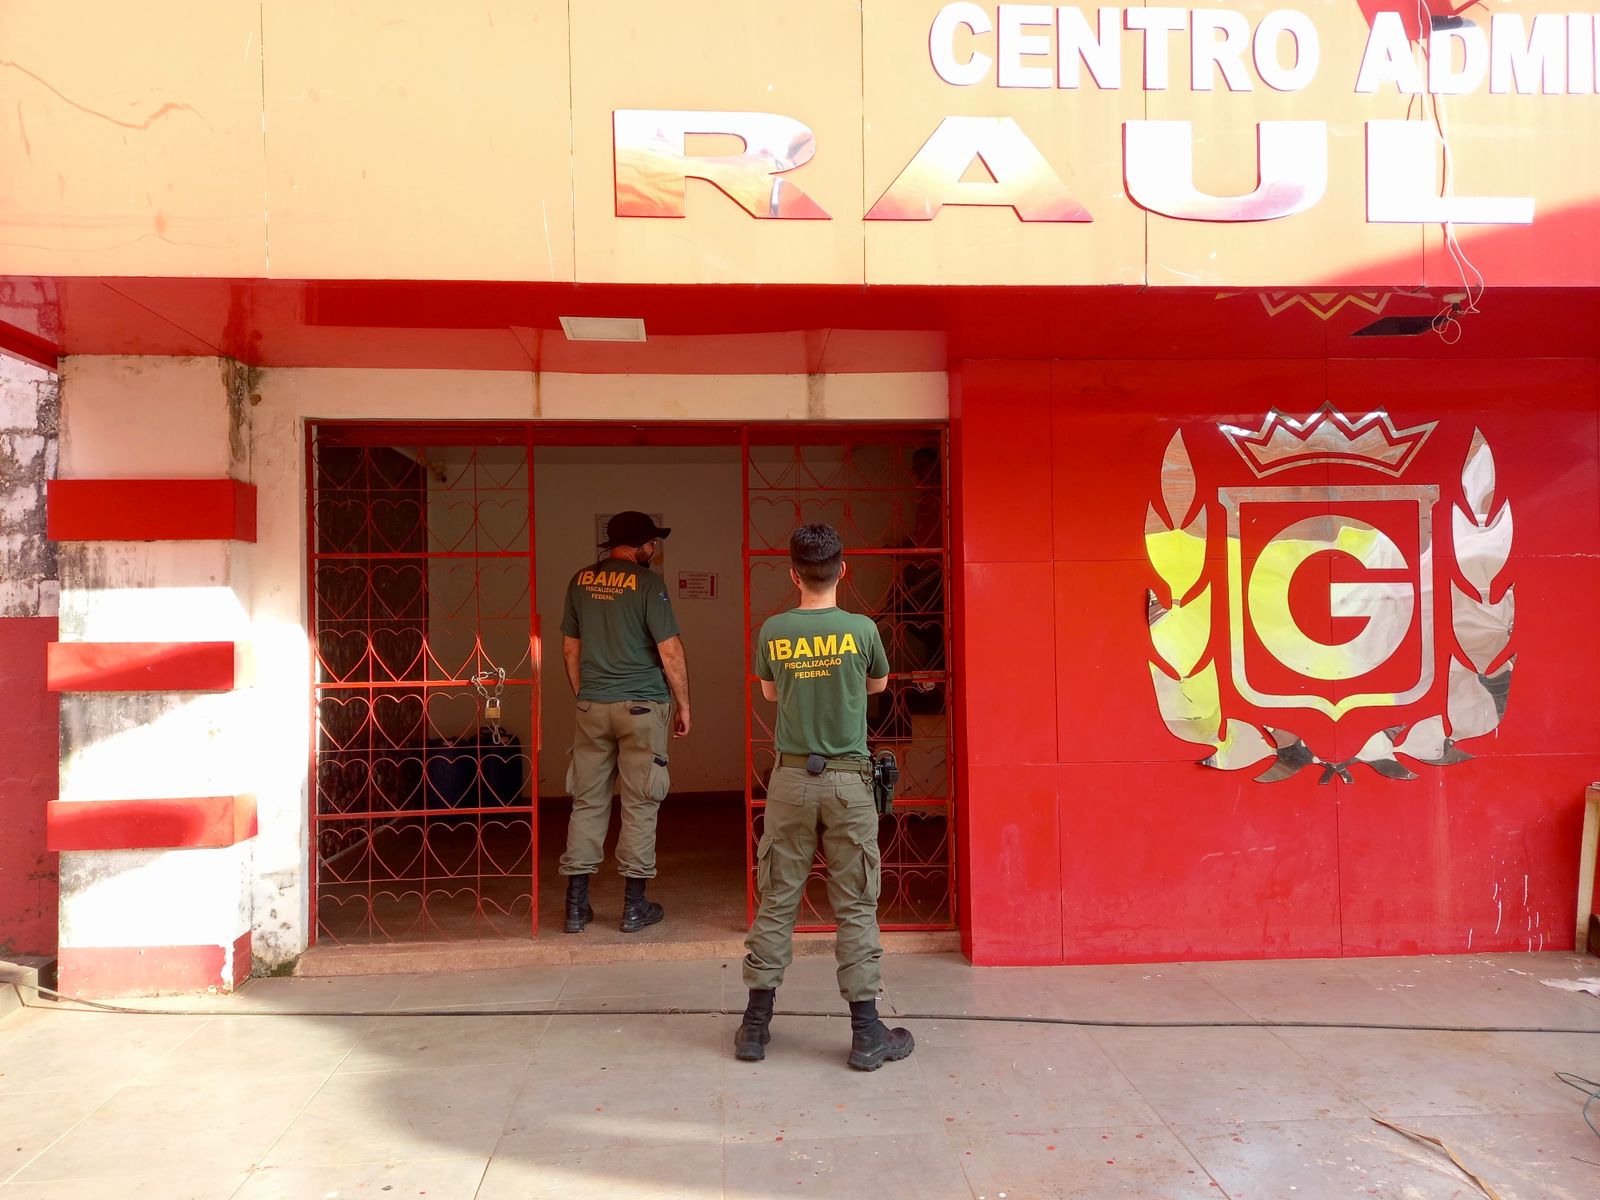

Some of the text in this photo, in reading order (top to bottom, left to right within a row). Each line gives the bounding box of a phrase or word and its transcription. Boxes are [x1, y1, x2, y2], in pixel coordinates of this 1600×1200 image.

[928, 1, 1599, 95] CENTRO ADMI
[612, 109, 1535, 223] RAUL
[576, 570, 637, 591] IBAMA
[591, 593, 615, 601] FEDERAL
[1247, 514, 1415, 680] G
[767, 633, 859, 661] IBAMA
[784, 657, 842, 670] FISCALIZAÇÃO
[794, 669, 831, 680] FEDERAL
